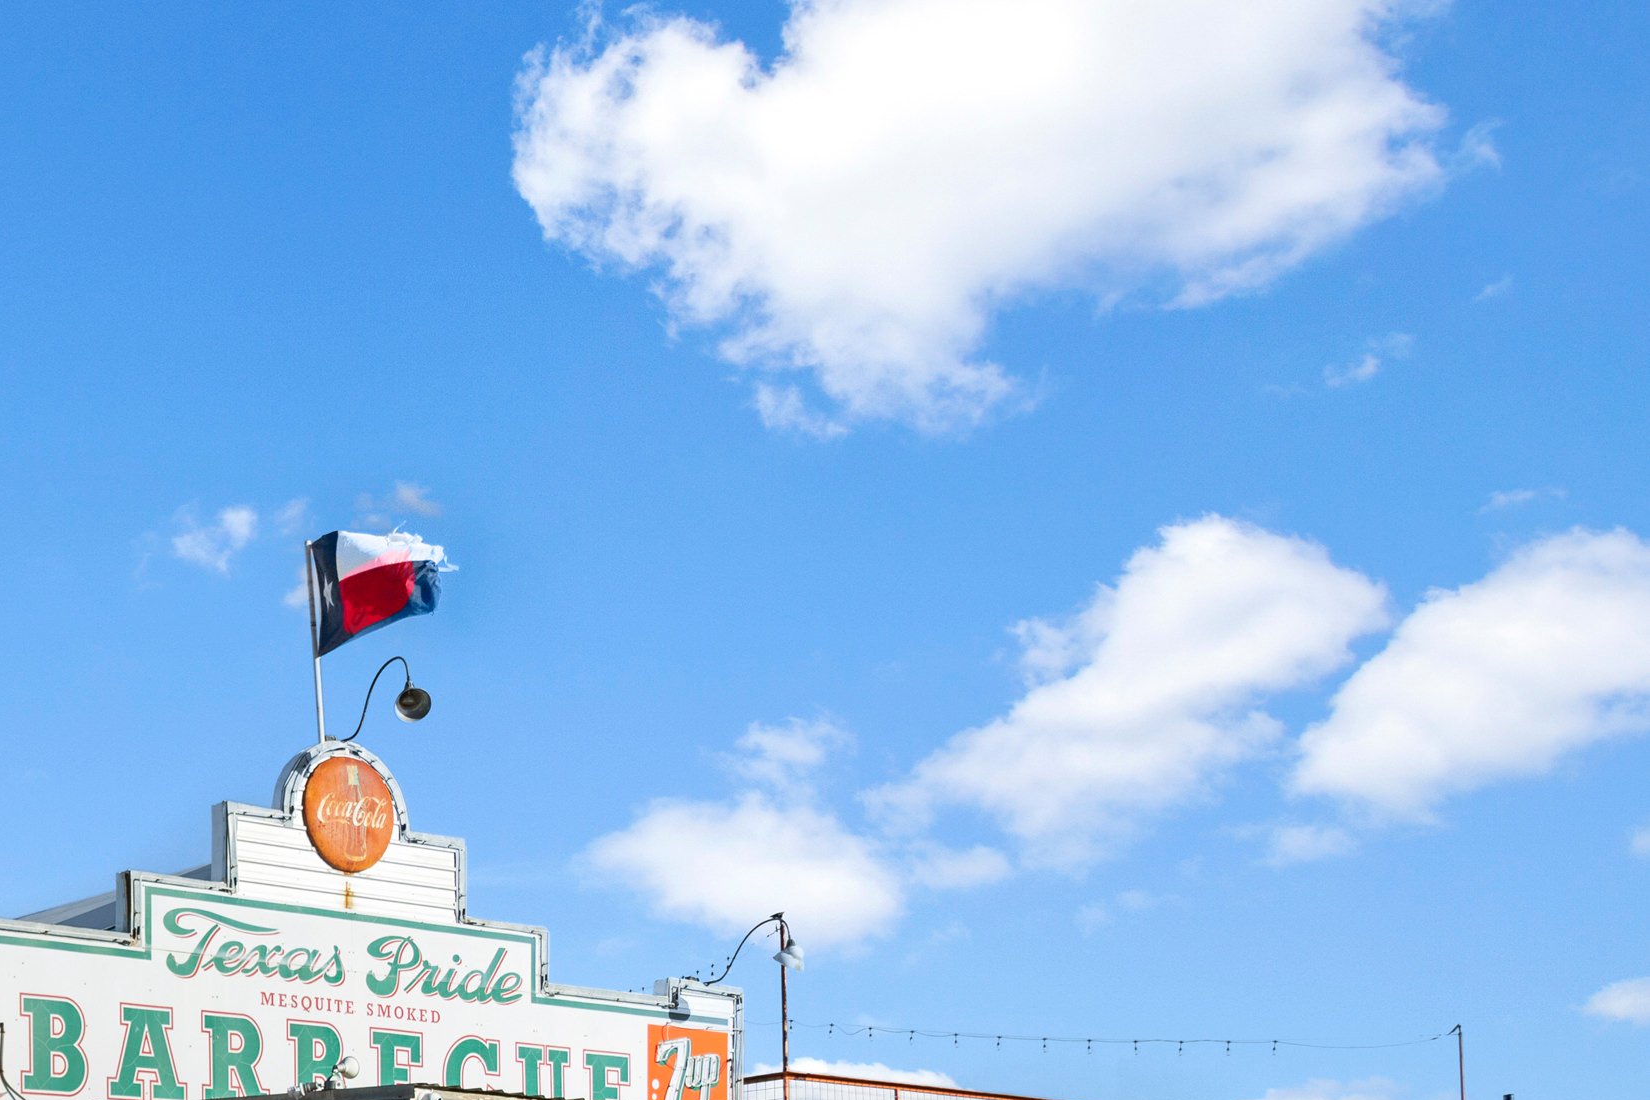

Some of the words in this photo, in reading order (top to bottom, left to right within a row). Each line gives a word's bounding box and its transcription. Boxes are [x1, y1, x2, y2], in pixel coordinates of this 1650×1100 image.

[163, 907, 345, 987] Texas
[365, 935, 524, 1006] Pride
[260, 991, 355, 1015] MESQUITE
[366, 1003, 442, 1024] SMOKED
